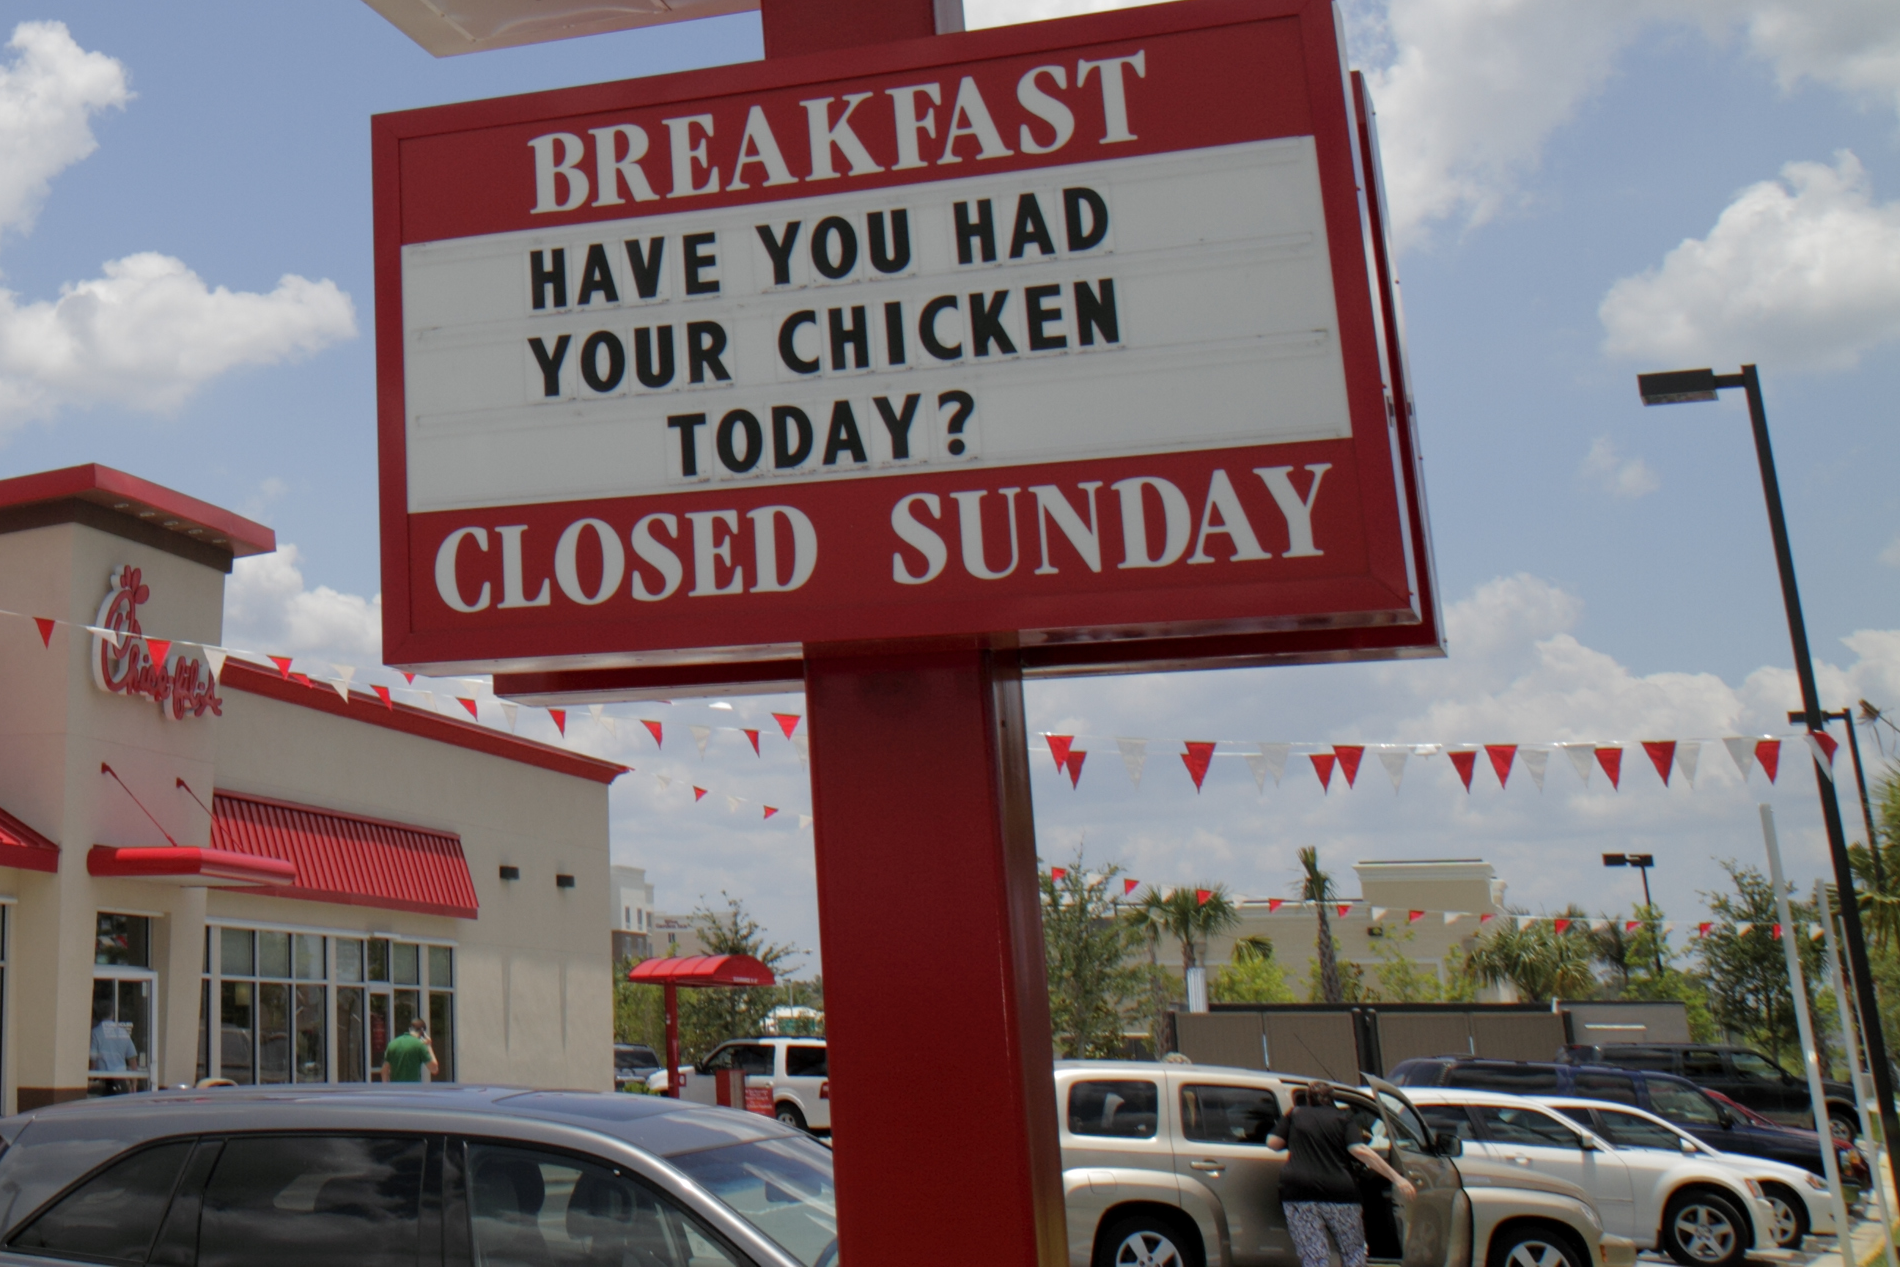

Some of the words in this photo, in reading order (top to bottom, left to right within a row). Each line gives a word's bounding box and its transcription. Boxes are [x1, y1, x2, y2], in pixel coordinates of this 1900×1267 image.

[527, 49, 1147, 215] BREAKFAST
[529, 231, 721, 311] HAVE
[755, 208, 912, 287] YOU
[952, 187, 1110, 266] HAD
[527, 319, 733, 398] YOUR
[777, 277, 1121, 375] CHICKEN
[666, 390, 976, 478] TODAY?
[433, 504, 819, 614] CLOSED
[890, 462, 1334, 586] SUNDAY
